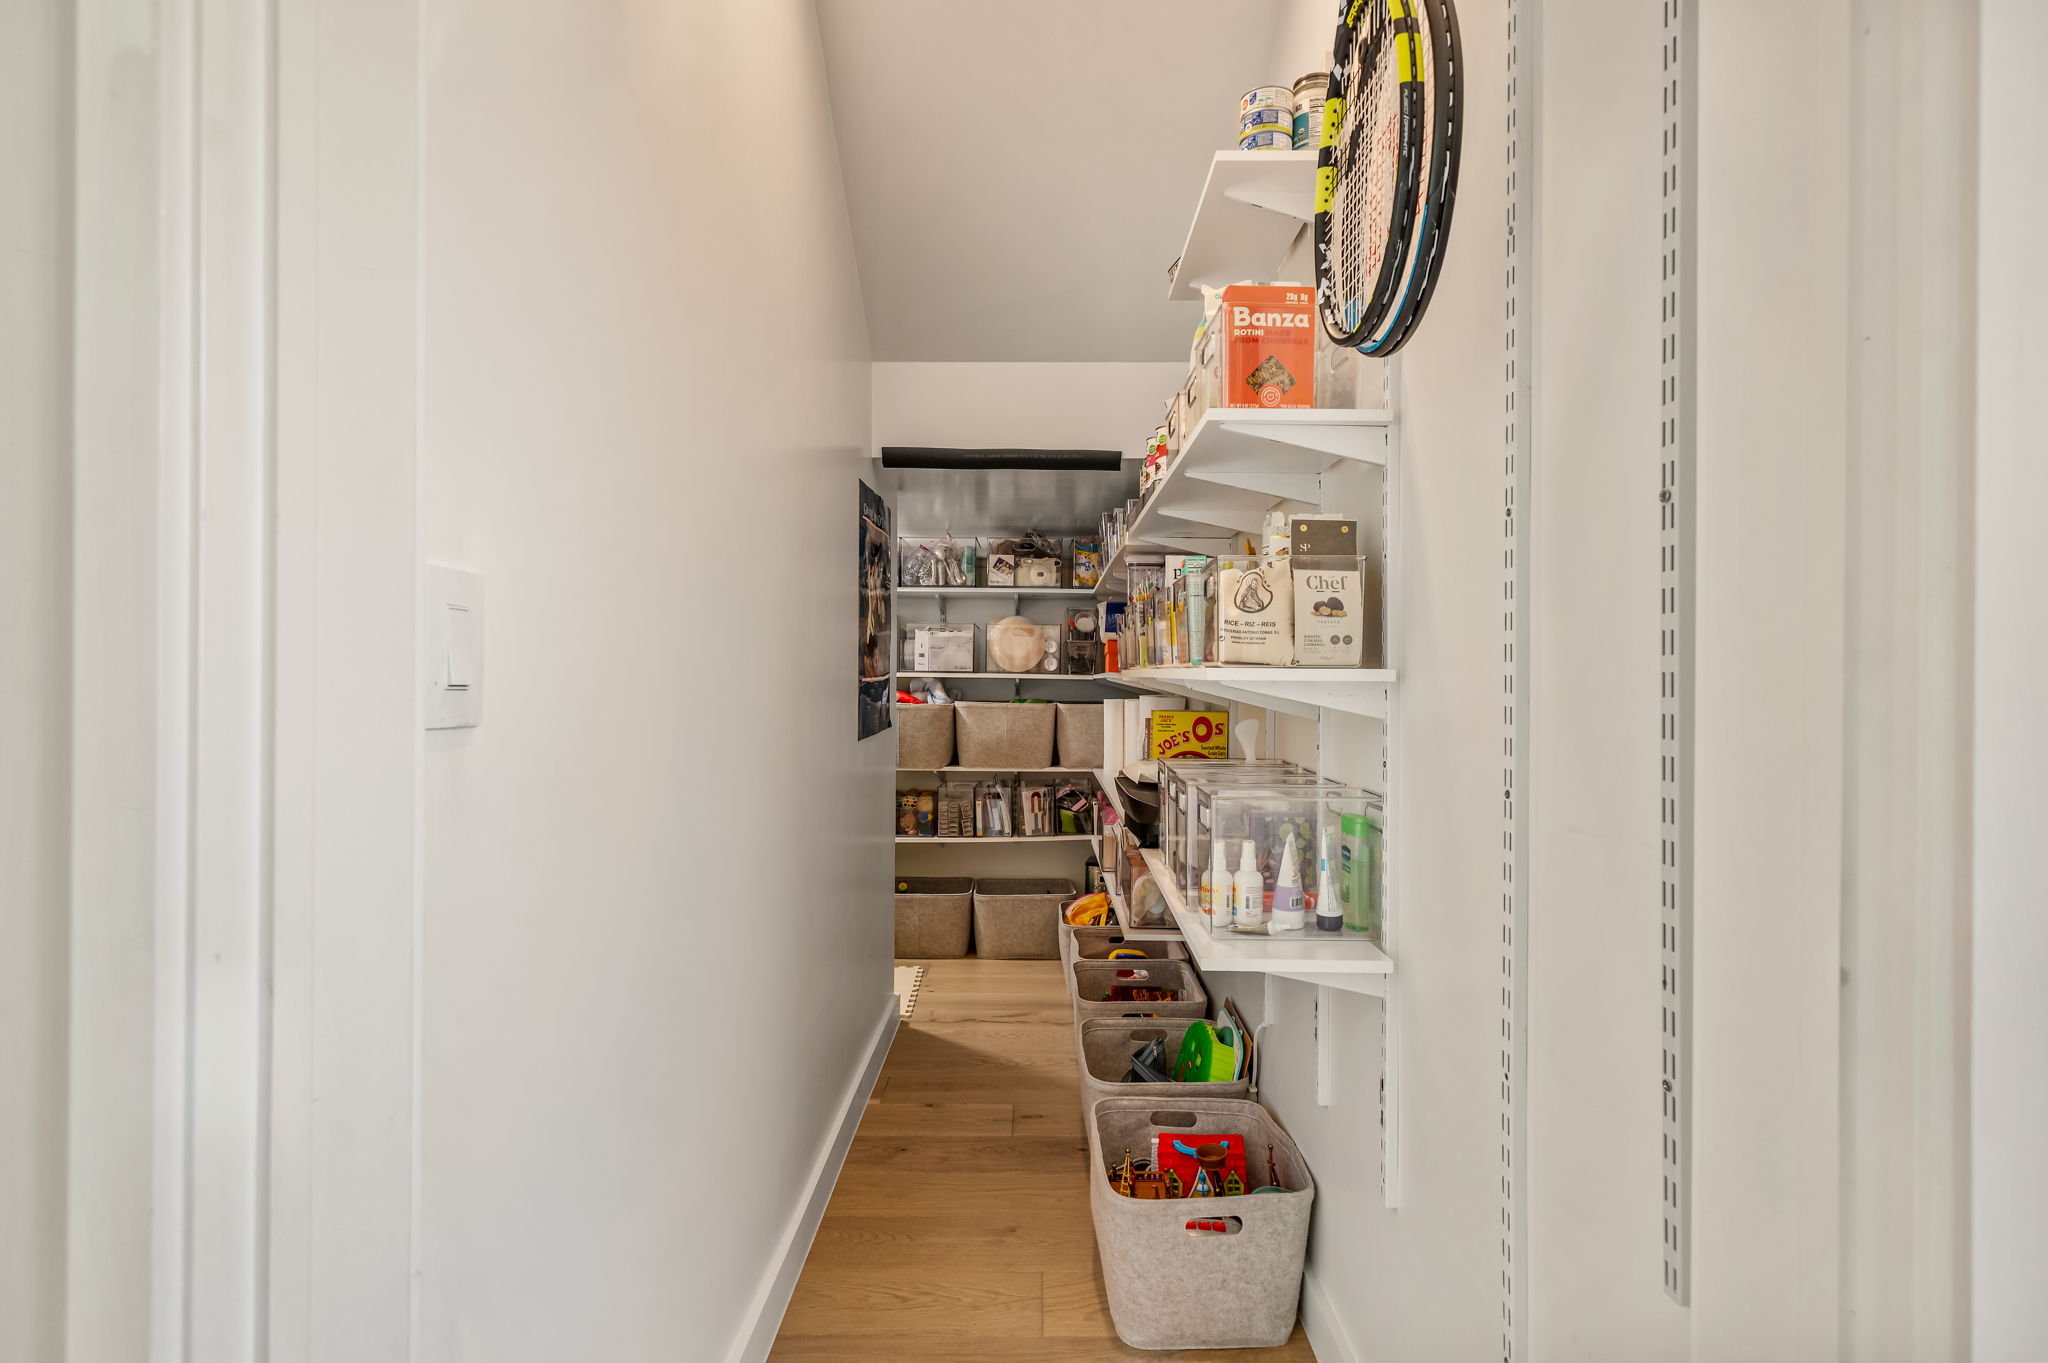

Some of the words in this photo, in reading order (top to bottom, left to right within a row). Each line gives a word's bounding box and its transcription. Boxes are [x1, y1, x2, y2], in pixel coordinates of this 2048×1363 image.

[1233, 306, 1310, 328] Banza
[1306, 575, 1348, 590] Chef
[1224, 619, 1240, 627] RICE
[1157, 730, 1190, 755] JOE'S
